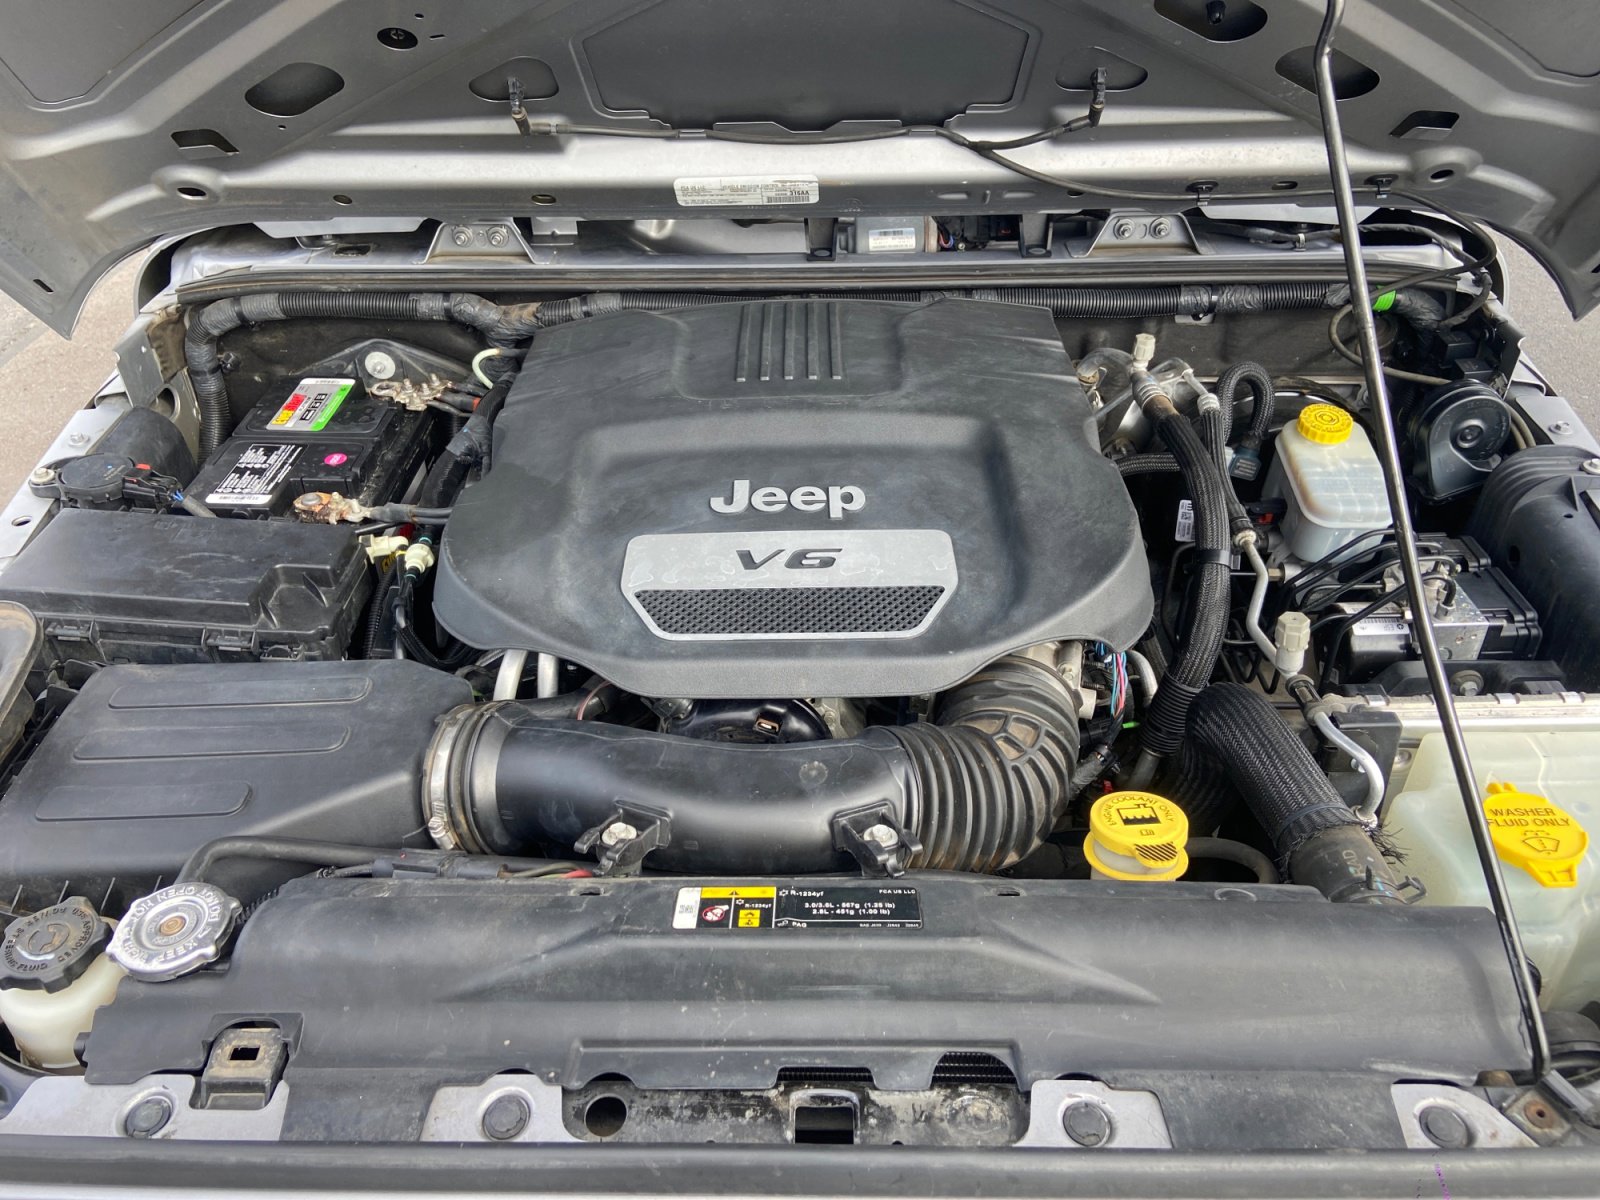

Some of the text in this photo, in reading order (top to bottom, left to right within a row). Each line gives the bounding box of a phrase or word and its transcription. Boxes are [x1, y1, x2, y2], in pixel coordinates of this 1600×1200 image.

[709, 479, 866, 521] Jeep
[736, 548, 843, 571] V6
[1103, 796, 1175, 827] ENGINE COOLANT ONLY
[1490, 808, 1556, 816] WASHER
[1486, 818, 1570, 827] FLUID ONLY
[156, 886, 196, 902] OPEN
[790, 890, 824, 898] R-1234yf
[57, 920, 92, 963] APPROVED
[155, 940, 199, 962] KEEP
[16, 962, 48, 972] FLUID
